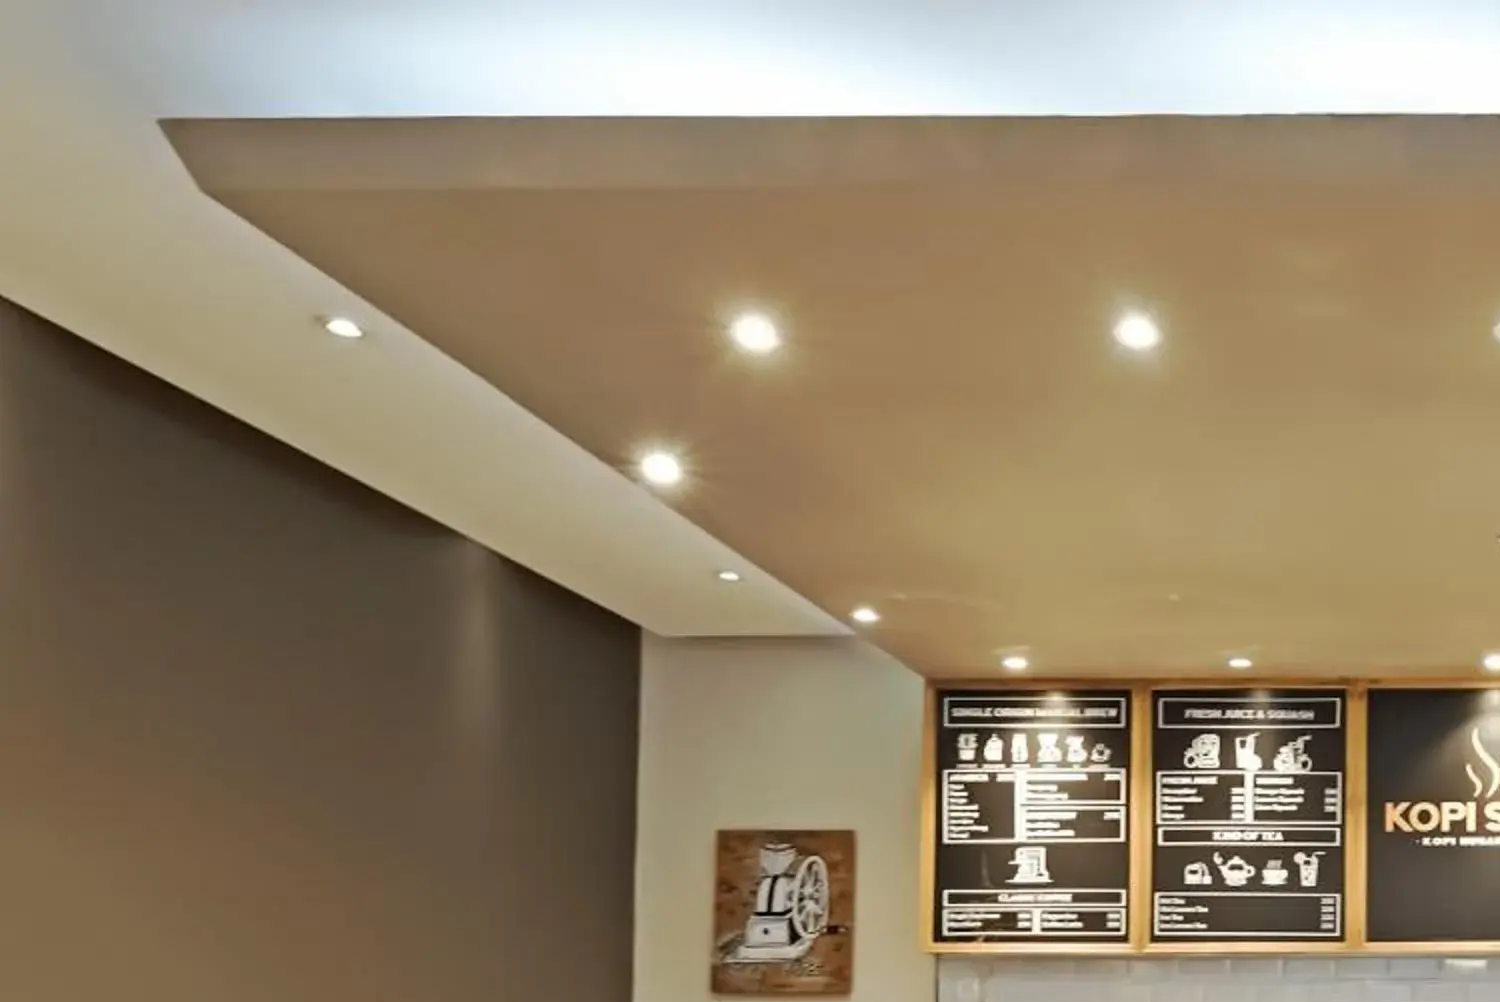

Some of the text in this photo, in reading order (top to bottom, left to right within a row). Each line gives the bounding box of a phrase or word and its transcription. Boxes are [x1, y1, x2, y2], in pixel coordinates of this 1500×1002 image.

[1384, 801, 1477, 833] KOPI
[1261, 832, 1284, 841] TEA
[1422, 836, 1456, 847] KOPI
